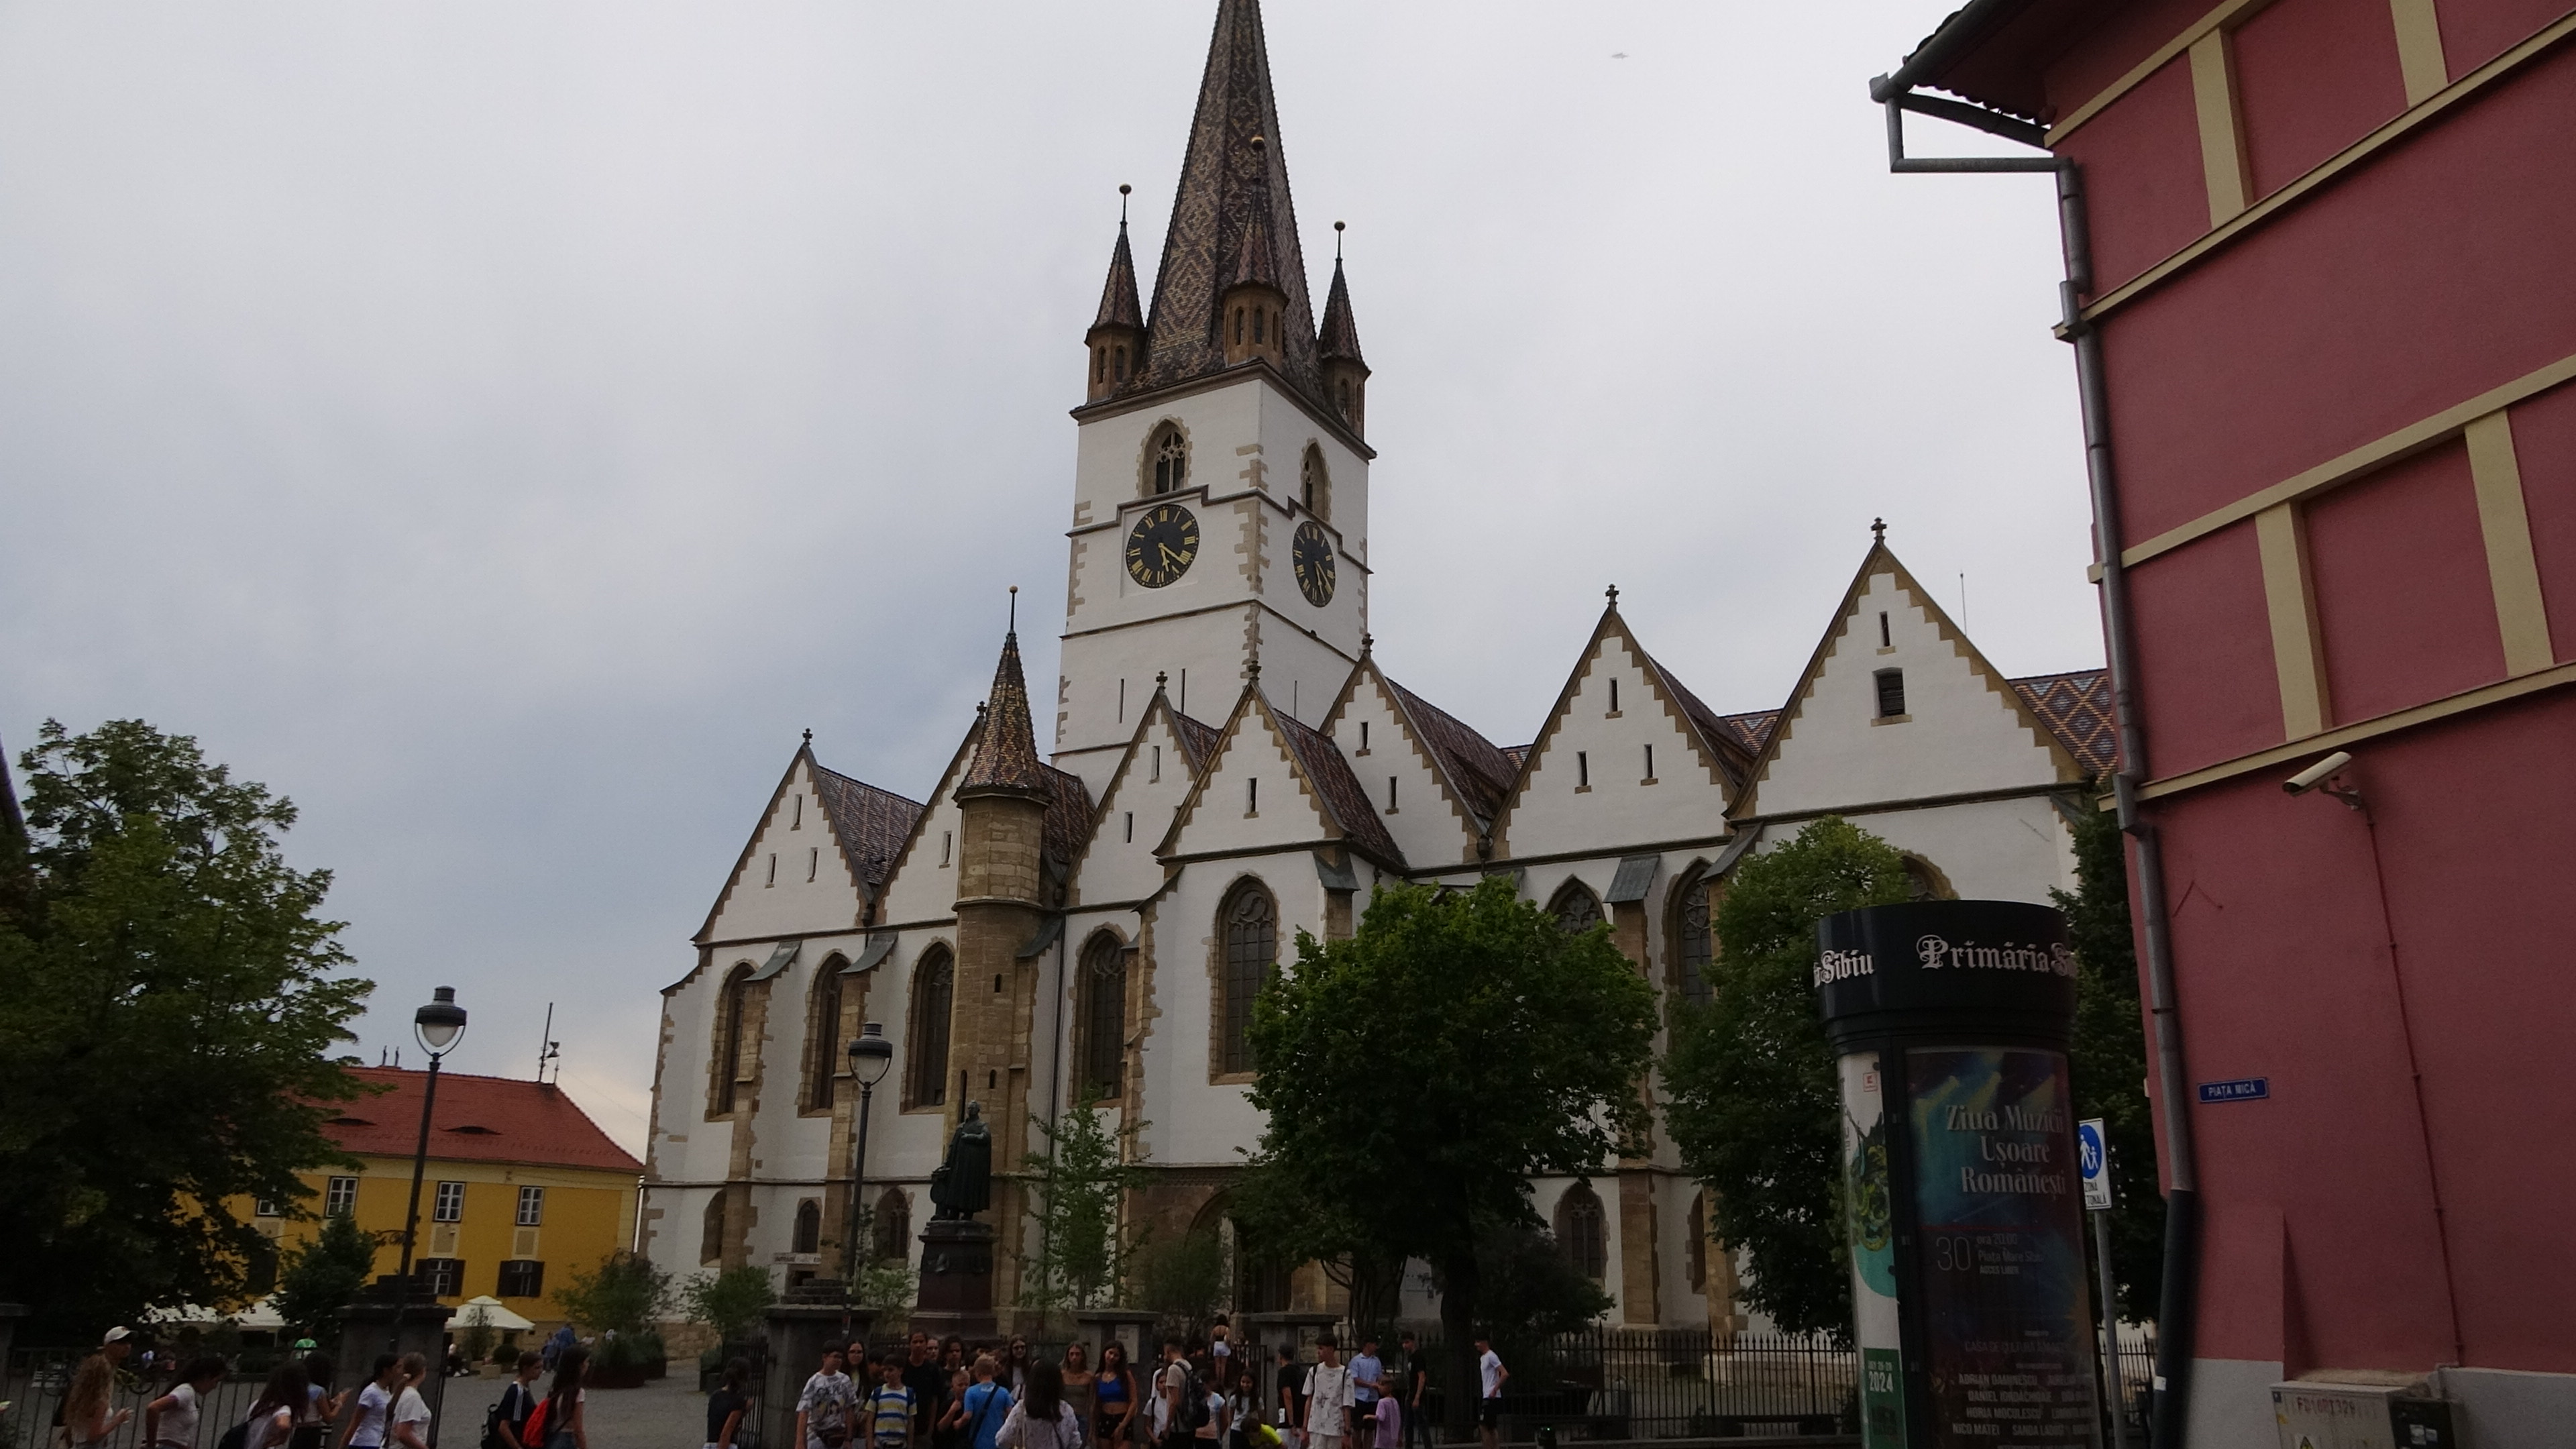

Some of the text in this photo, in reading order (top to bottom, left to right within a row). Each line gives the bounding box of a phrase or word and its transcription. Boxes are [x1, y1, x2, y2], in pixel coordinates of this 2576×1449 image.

[1821, 949, 1875, 983] Sibiu
[1946, 1104, 2064, 1133] Ziua Muzicii
[1980, 1135, 2050, 1169] Ușoare
[1960, 1166, 2067, 1201] Românești
[1936, 1236, 1972, 1271] 30
[1868, 1371, 1894, 1393] 2024
